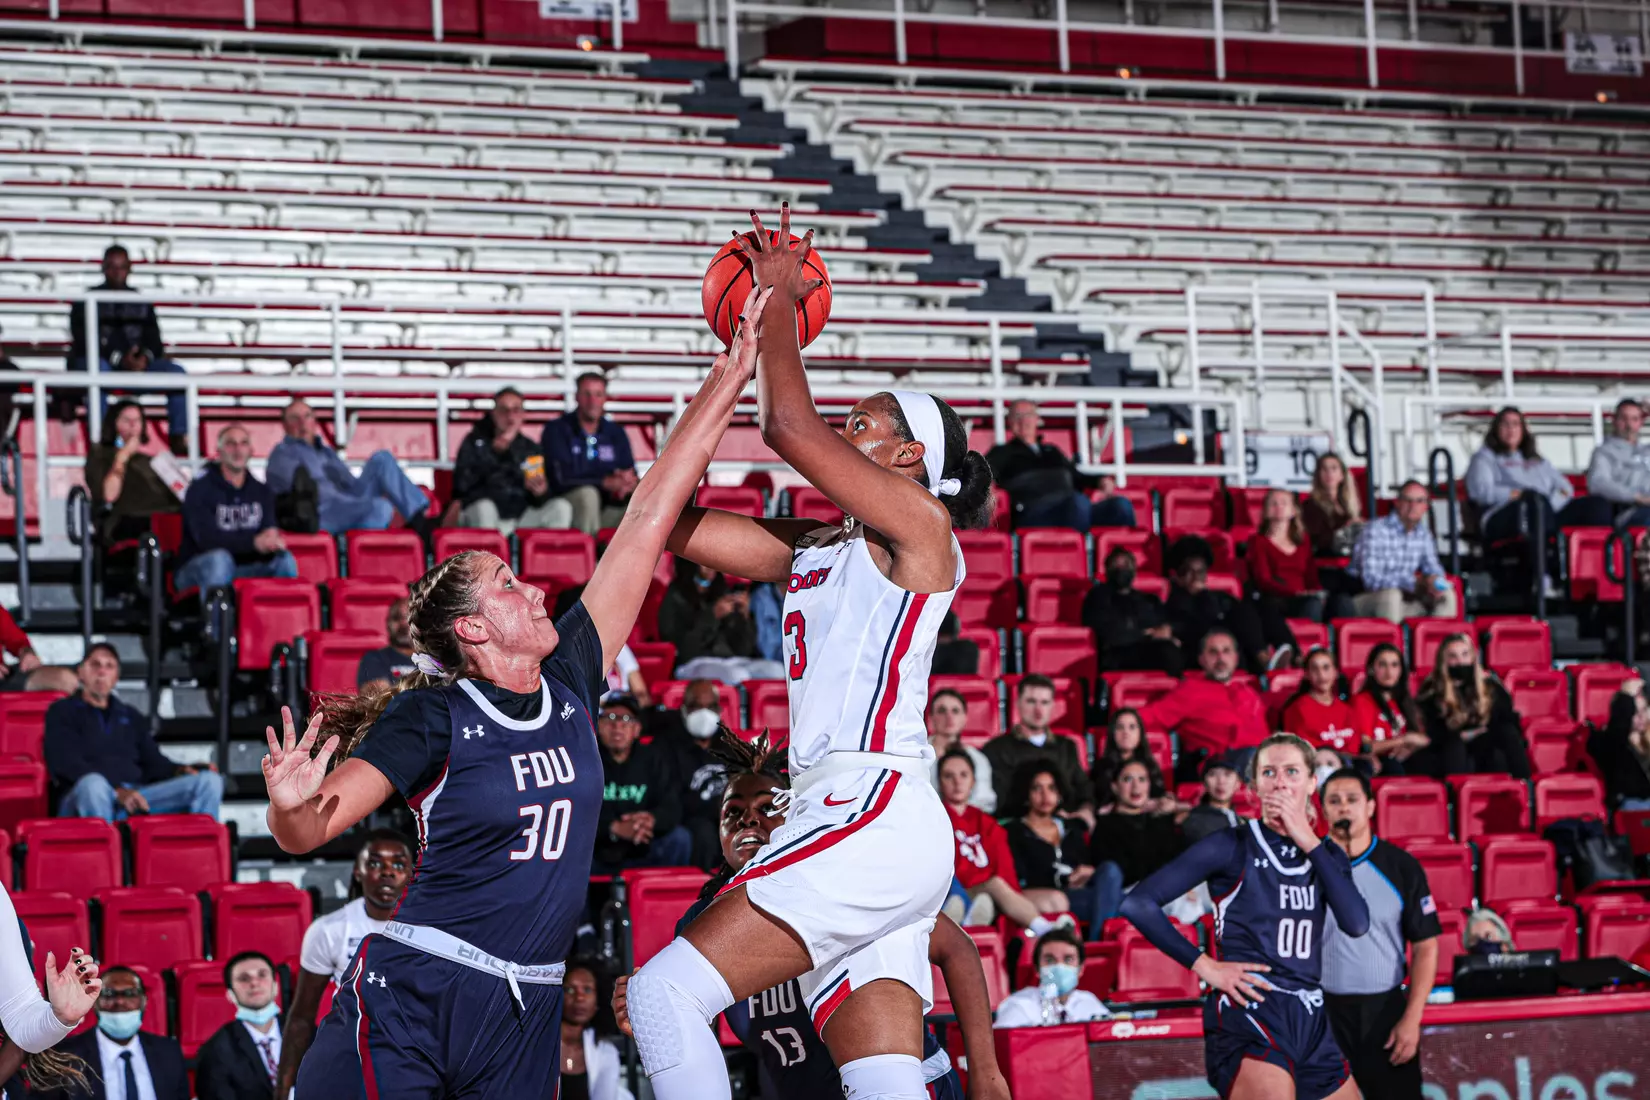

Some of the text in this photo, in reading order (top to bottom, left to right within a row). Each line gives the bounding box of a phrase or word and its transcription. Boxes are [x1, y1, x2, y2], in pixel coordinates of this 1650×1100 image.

[1289, 448, 1318, 476] 10
[783, 609, 807, 682] 3
[509, 745, 576, 792] FDU
[507, 798, 573, 863] 30
[1279, 883, 1315, 911] FDU
[1277, 917, 1313, 960] 00
[748, 979, 797, 1019] FDU
[760, 1026, 807, 1067] 13
